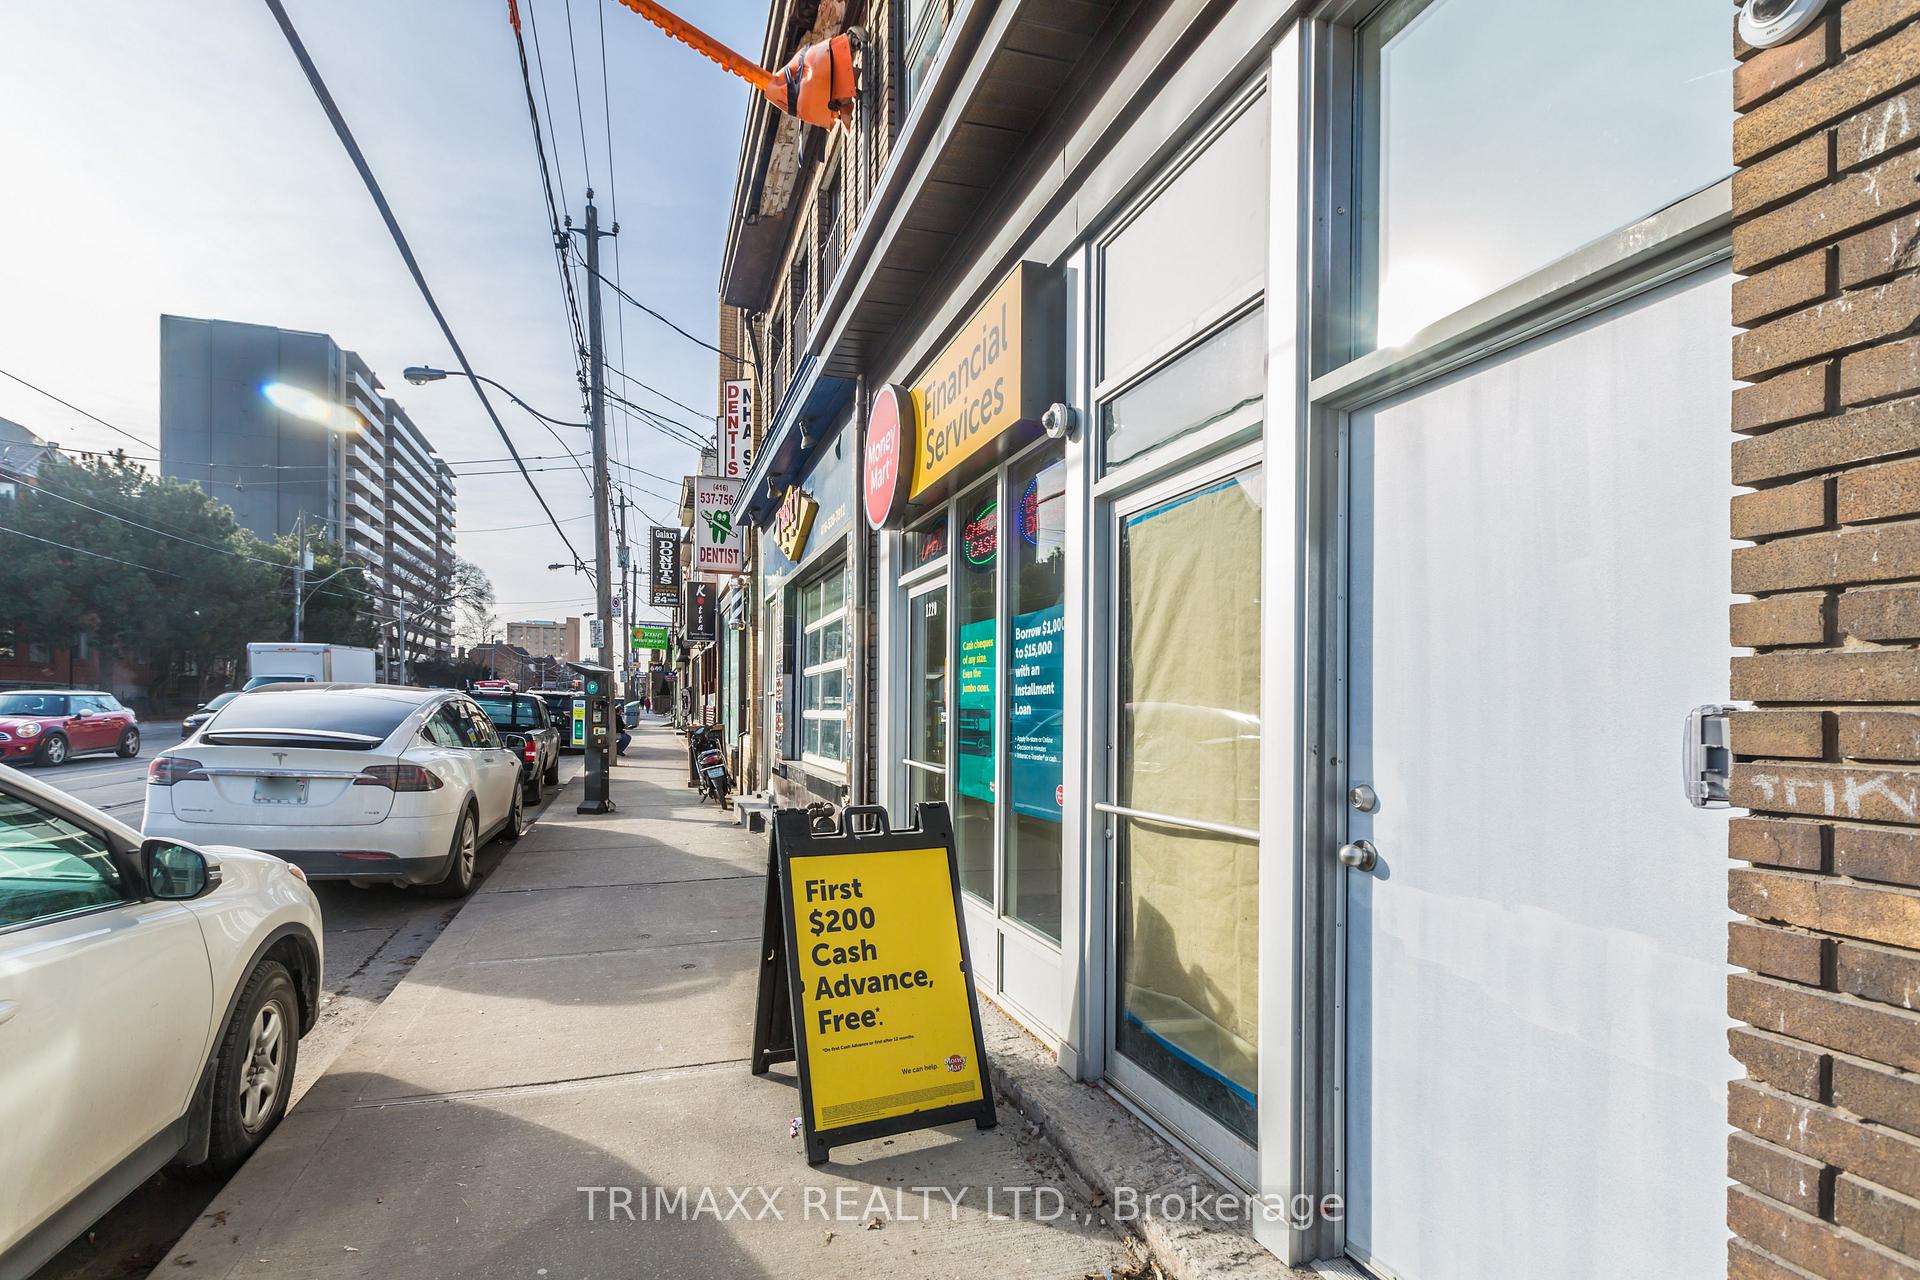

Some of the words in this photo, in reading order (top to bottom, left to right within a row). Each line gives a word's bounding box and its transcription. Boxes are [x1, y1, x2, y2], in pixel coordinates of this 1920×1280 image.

[924, 303, 1008, 428] Financial
[727, 385, 739, 476] DENTIS
[926, 376, 1004, 470] Services
[868, 423, 897, 466] Money
[870, 460, 893, 494] Mart
[713, 483, 729, 492] (416)
[700, 493, 734, 506] 537-756
[655, 530, 678, 542] Galaxy
[659, 540, 674, 585] DONUTS
[700, 547, 739, 564] DENTIST
[1015, 626, 1041, 641] Borrow
[1042, 616, 1065, 637] $1,000
[962, 641, 974, 651] Cash
[973, 639, 994, 650] cheques
[1015, 648, 1024, 659] to
[1024, 641, 1053, 659] $15,000
[962, 655, 968, 664] of
[968, 656, 976, 665] any
[962, 669, 973, 679] Even
[973, 668, 982, 678] the
[1015, 663, 1031, 678] with
[1031, 665, 1040, 676] an
[962, 683, 976, 695] jumbo
[1015, 682, 1055, 697] Installment
[1015, 703, 1032, 716] Loan
[805, 879, 864, 903] First
[809, 906, 876, 937] $200
[811, 939, 878, 967] Cash
[815, 969, 934, 1001] Advance,
[943, 1056, 967, 1065] Money
[901, 1067, 912, 1075] We
